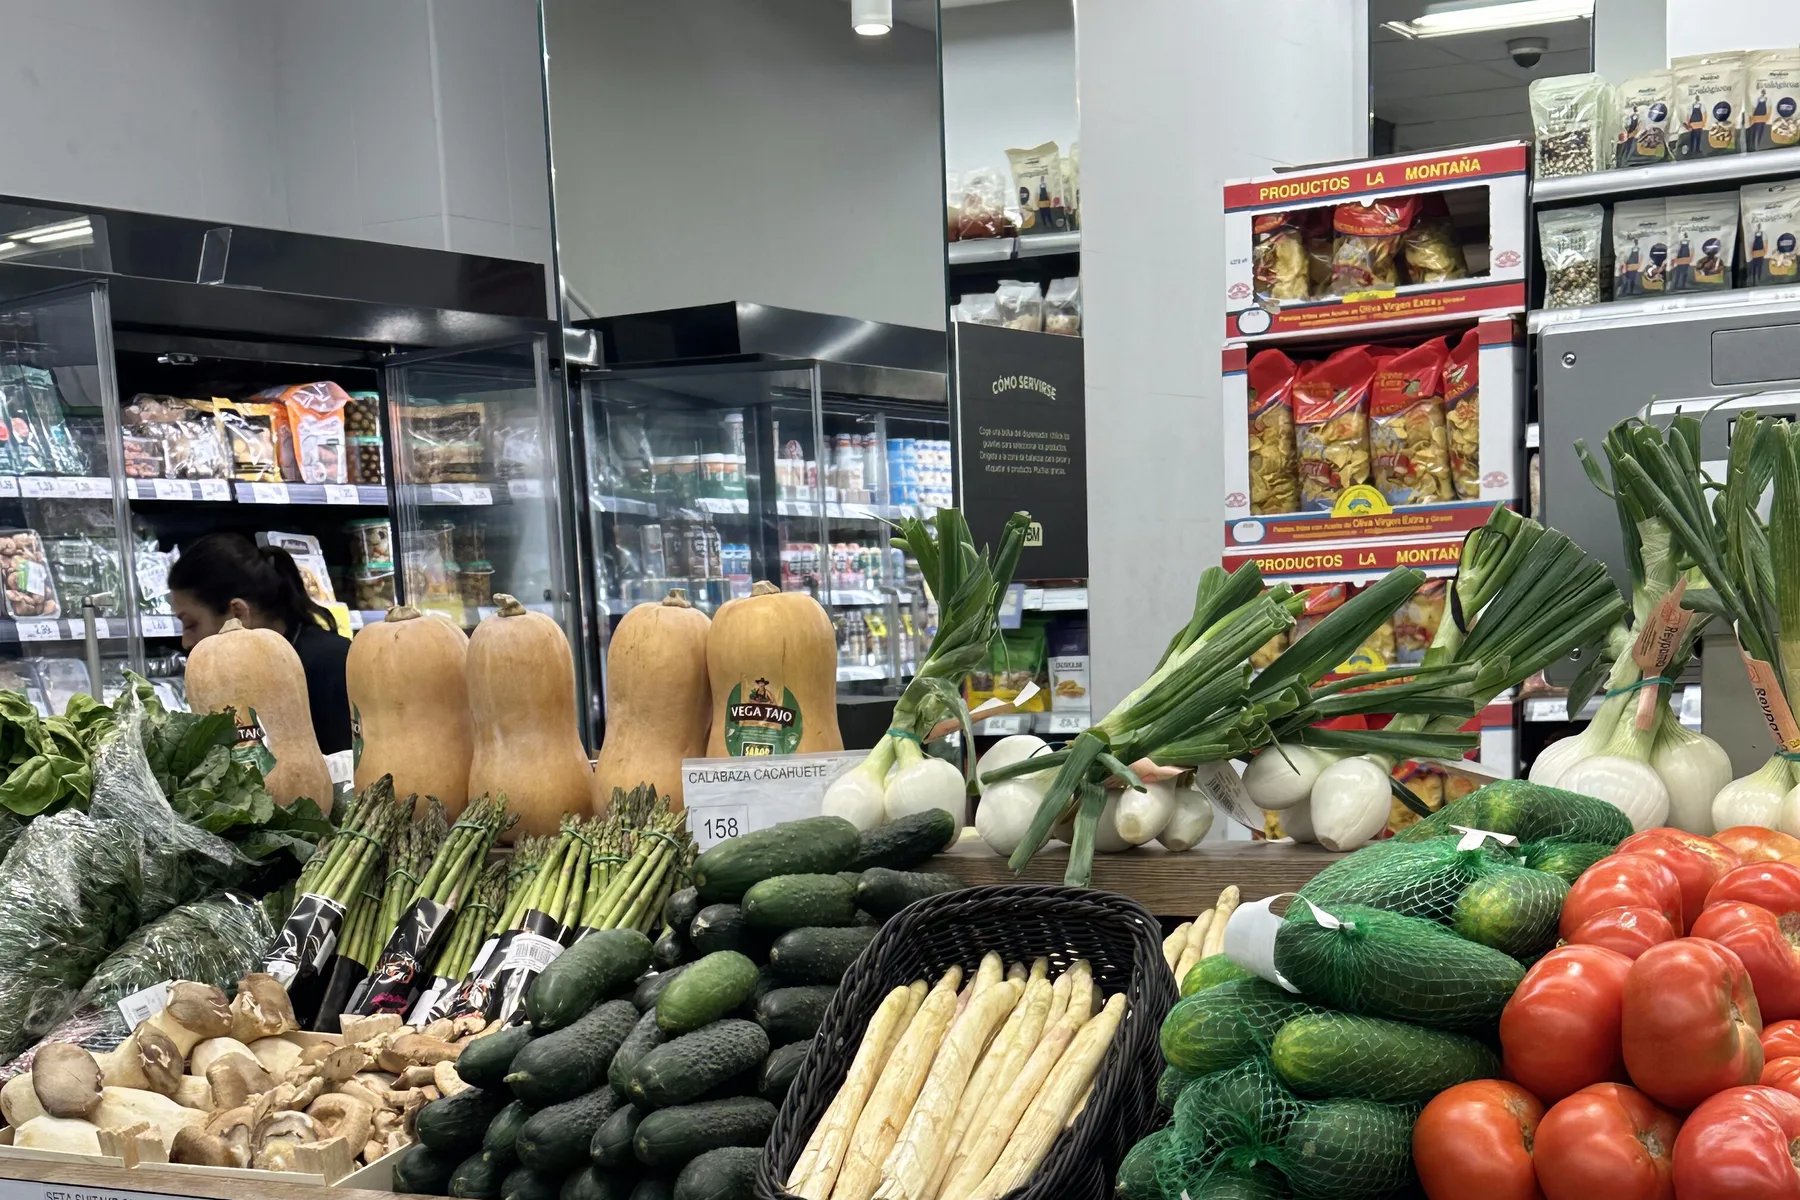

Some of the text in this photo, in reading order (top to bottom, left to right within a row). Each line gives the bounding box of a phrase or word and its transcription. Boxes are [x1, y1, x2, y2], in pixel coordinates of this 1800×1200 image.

[1260, 156, 1481, 200] PRODUCTOS LA MONTAÑA
[992, 375, 1056, 400] CÓMO SERVIRSE
[1256, 543, 1460, 572] PRODUCTOS LA MONTAÑ
[731, 705, 792, 722] VEGA TAJO
[688, 765, 827, 784] CALABAZA CACAHUETE
[704, 817, 739, 839] 158
